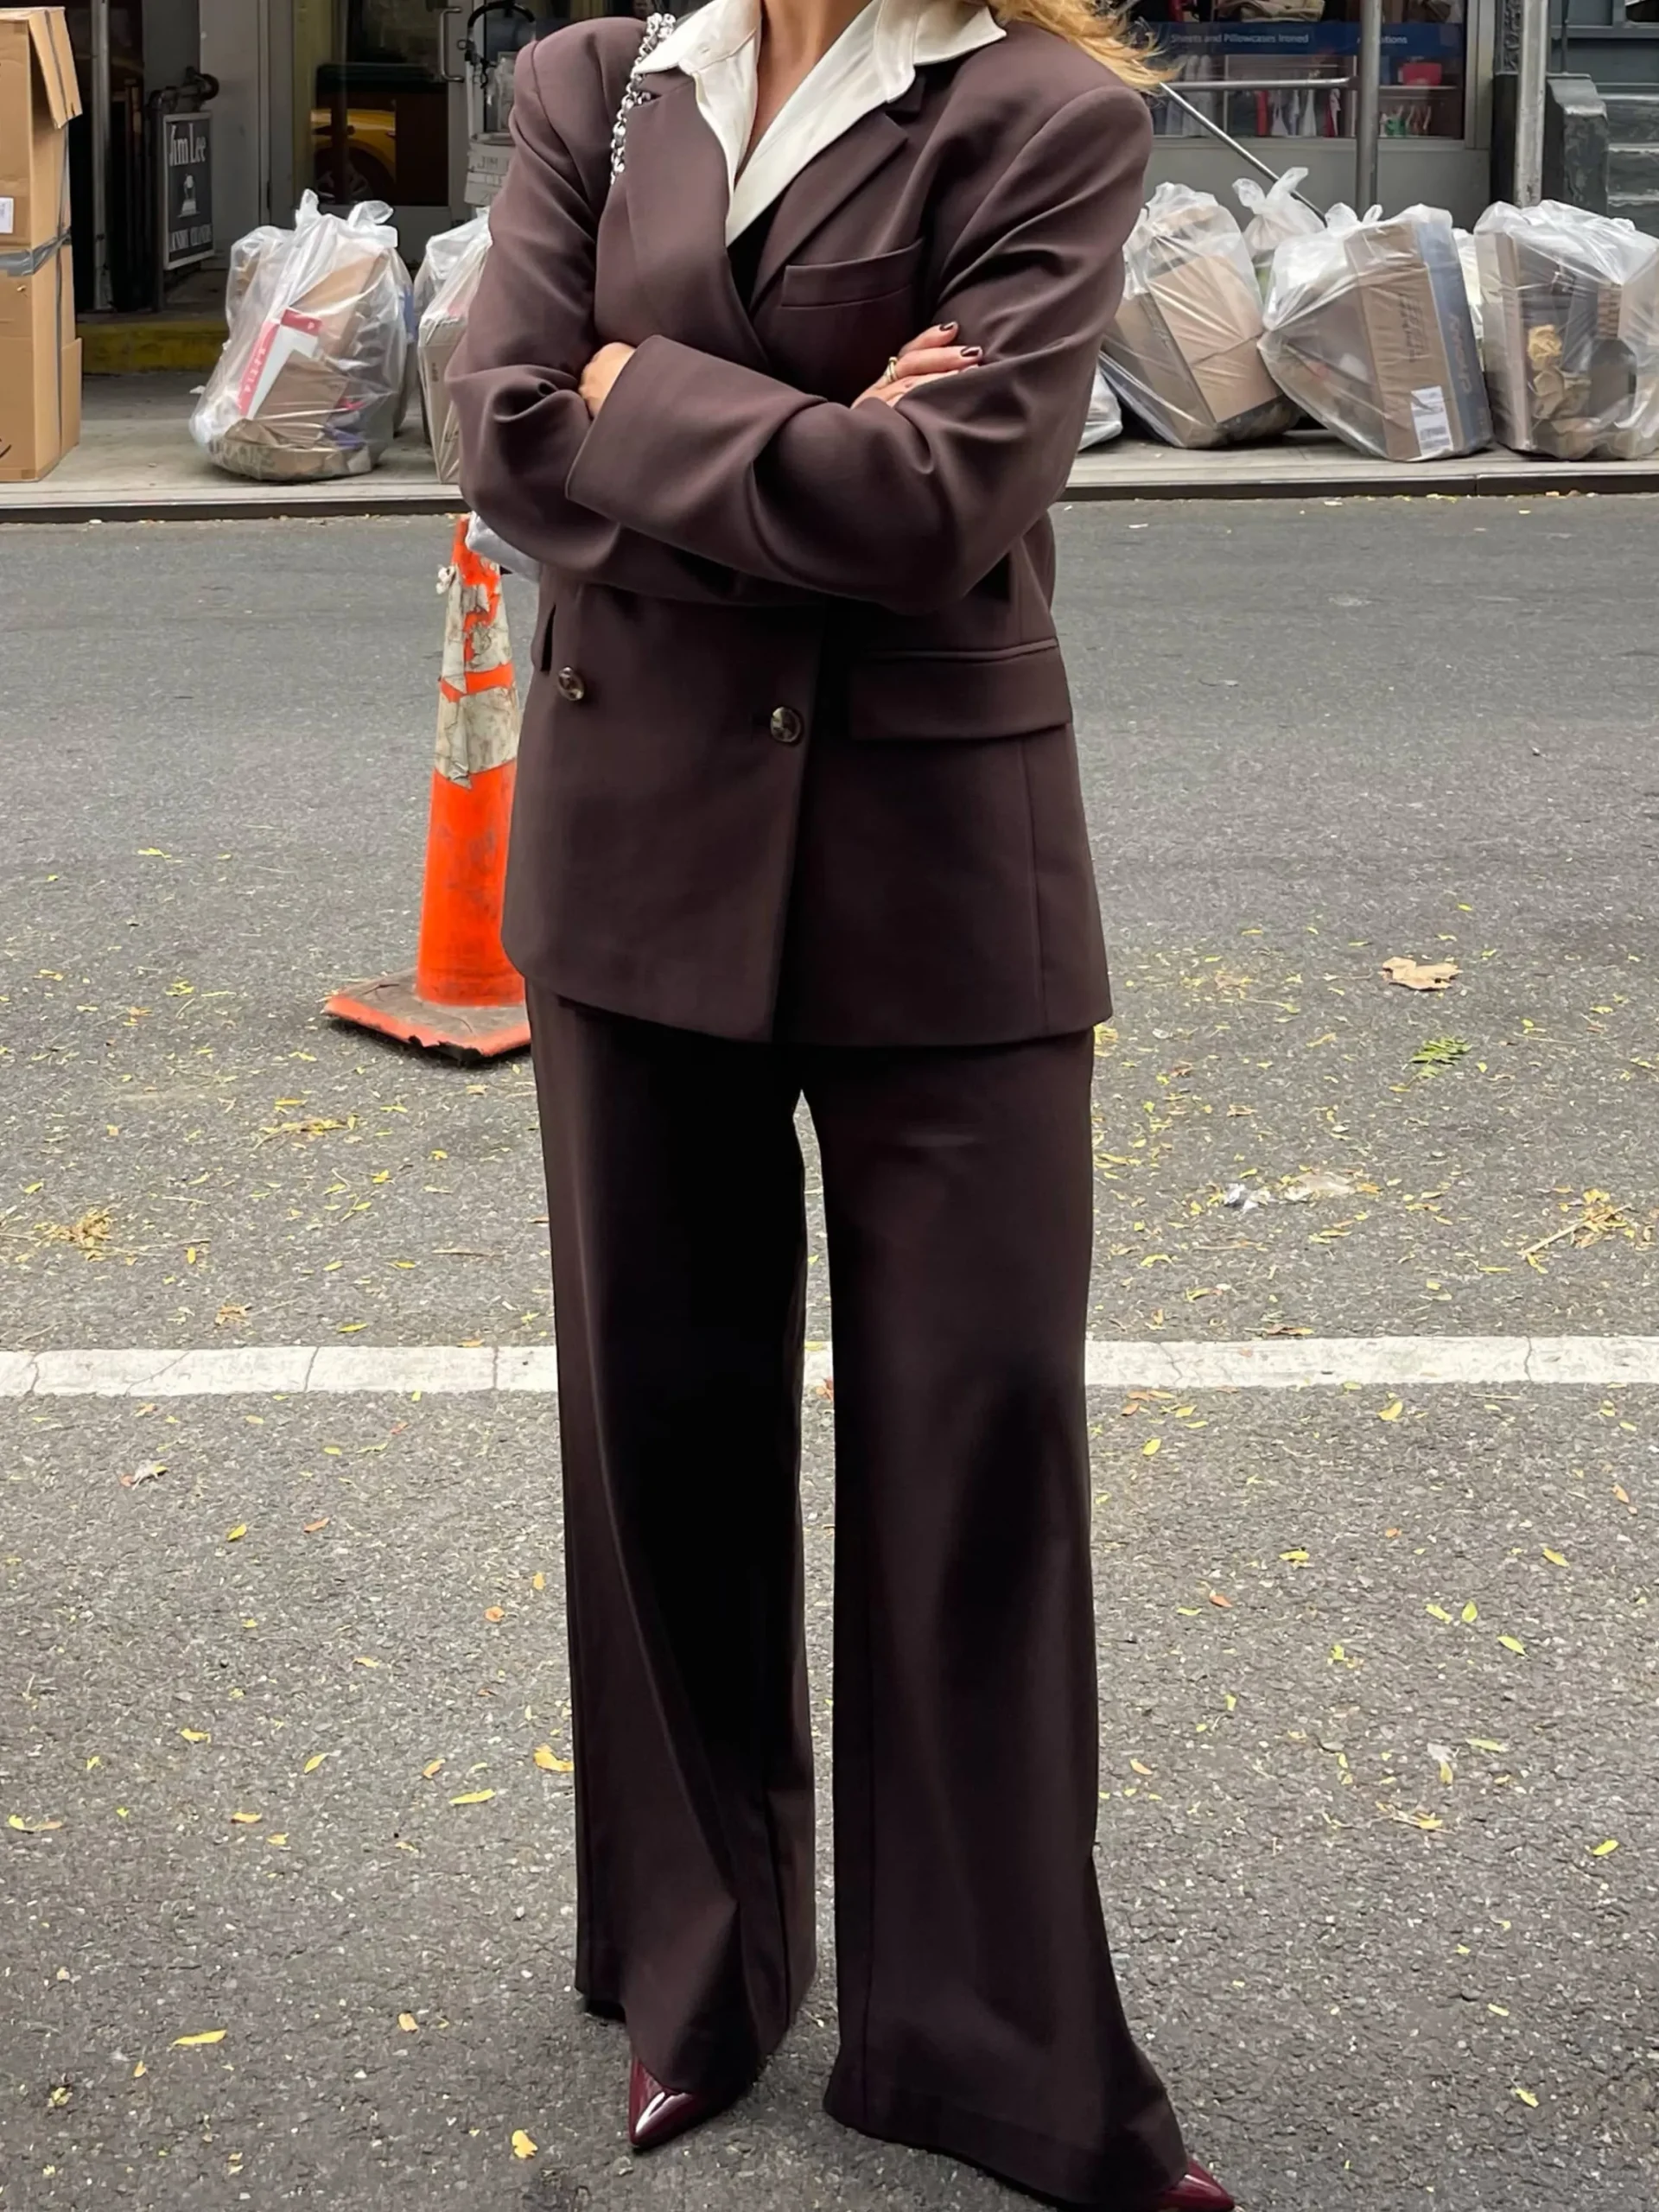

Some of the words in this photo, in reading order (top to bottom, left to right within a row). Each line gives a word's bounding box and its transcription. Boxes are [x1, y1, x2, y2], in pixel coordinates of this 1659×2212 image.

[1205, 34, 1222, 42] and
[1224, 33, 1275, 42] Pillowcases
[1279, 34, 1308, 42] Ironed
[188, 123, 207, 163] Lee
